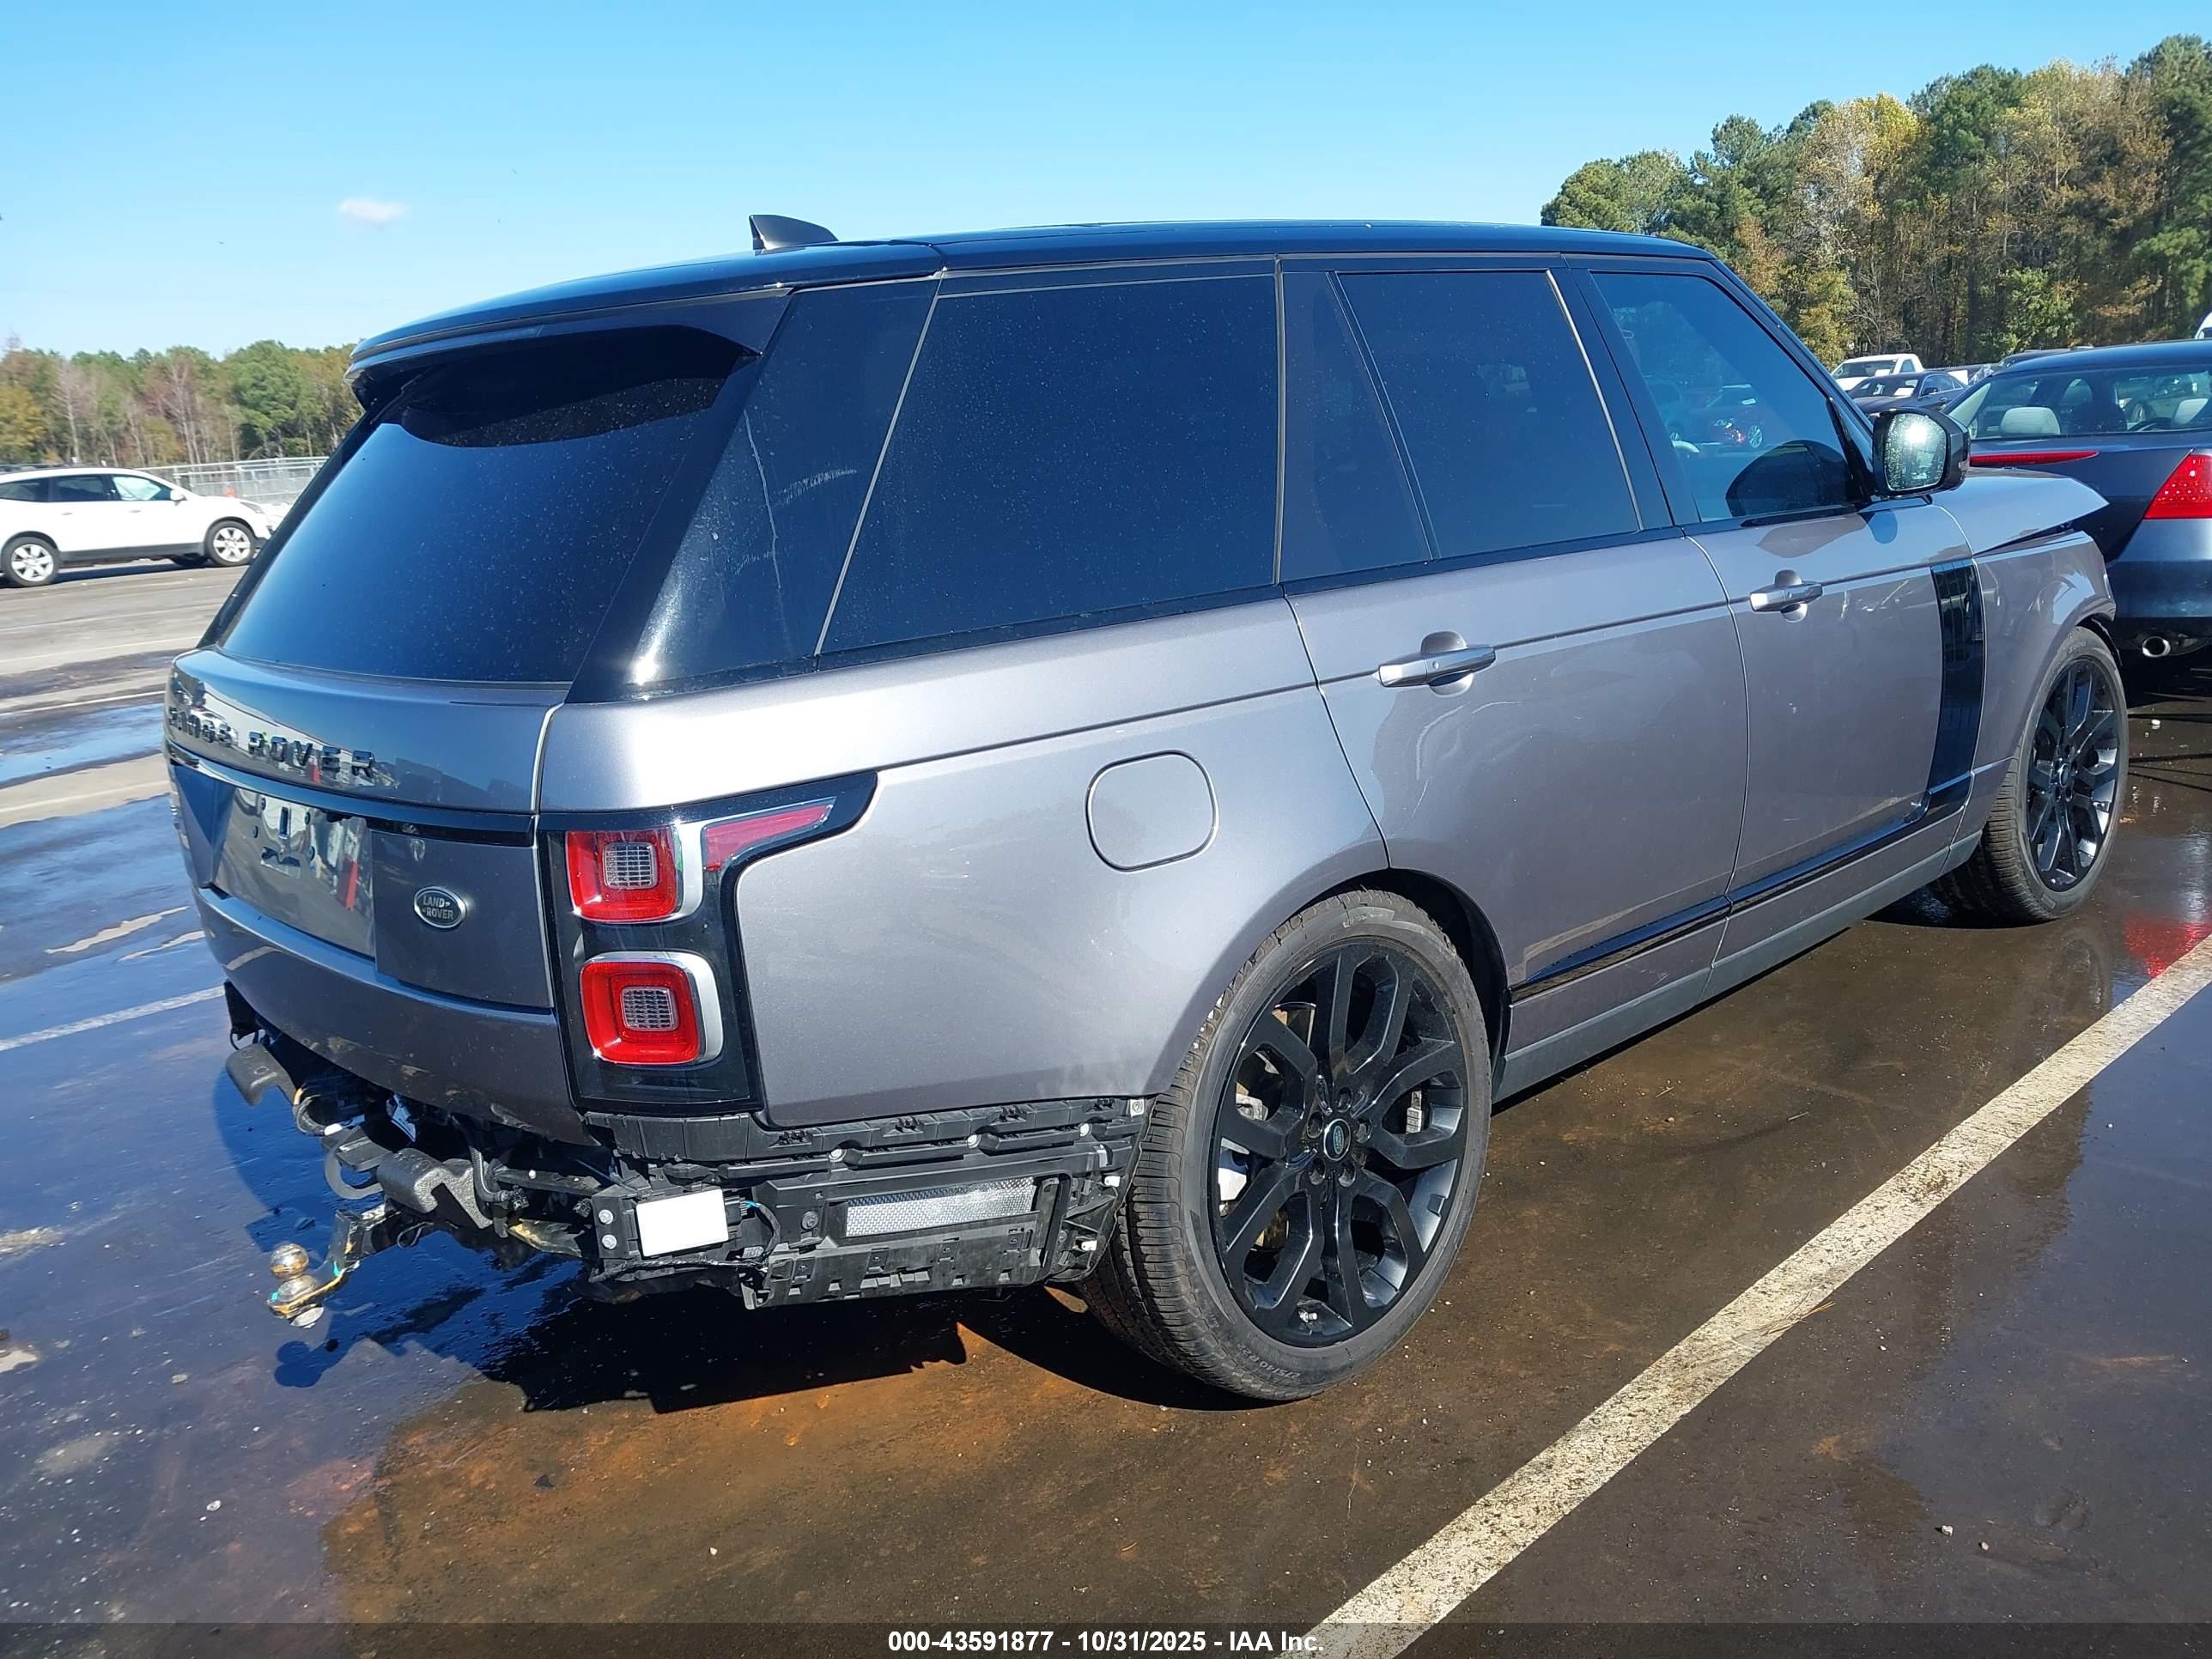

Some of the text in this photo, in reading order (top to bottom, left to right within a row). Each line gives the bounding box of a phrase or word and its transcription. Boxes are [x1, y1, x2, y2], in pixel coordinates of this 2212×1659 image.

[248, 731, 376, 778] ROVER
[422, 895, 445, 908] LAND
[426, 907, 453, 920] ROVER
